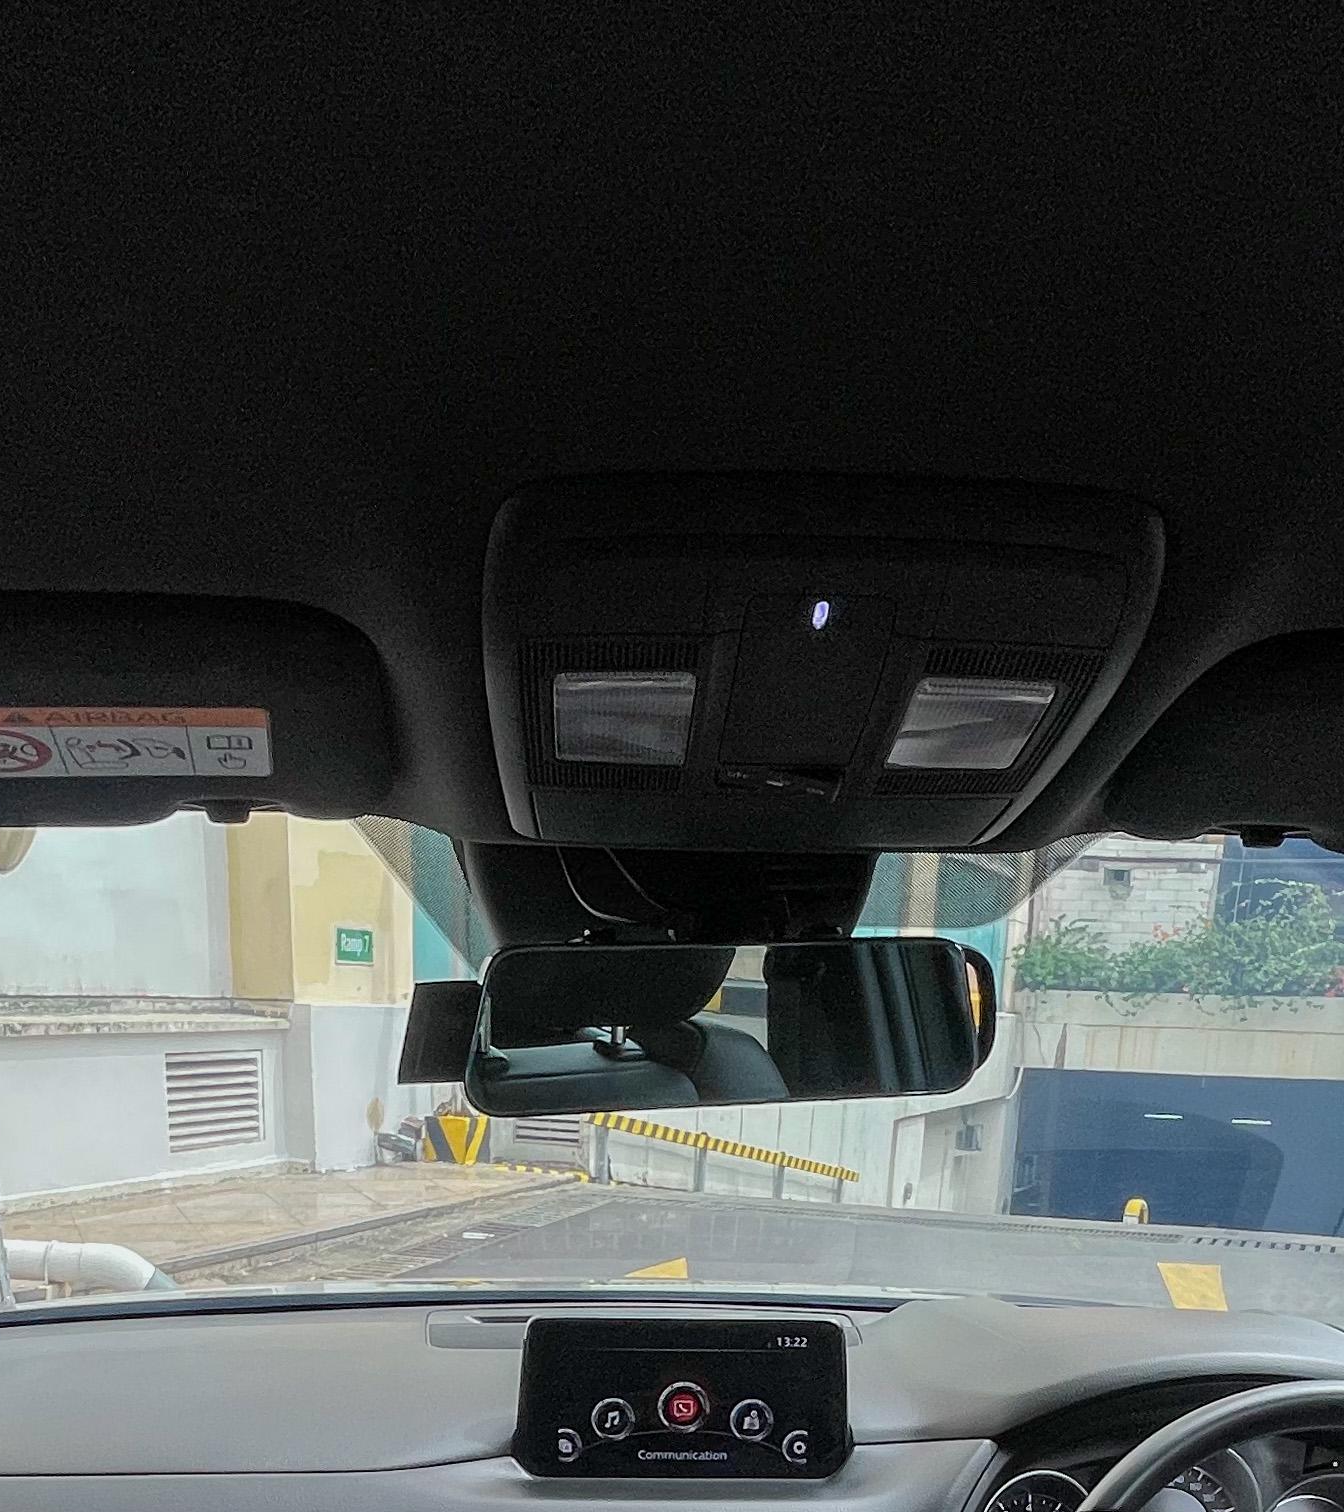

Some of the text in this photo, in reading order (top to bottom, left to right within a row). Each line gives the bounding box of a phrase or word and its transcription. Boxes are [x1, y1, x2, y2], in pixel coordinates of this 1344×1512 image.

[45, 710, 187, 724] AIRBAG
[776, 1336, 808, 1348] 13:22
[637, 1449, 728, 1461] Communication
